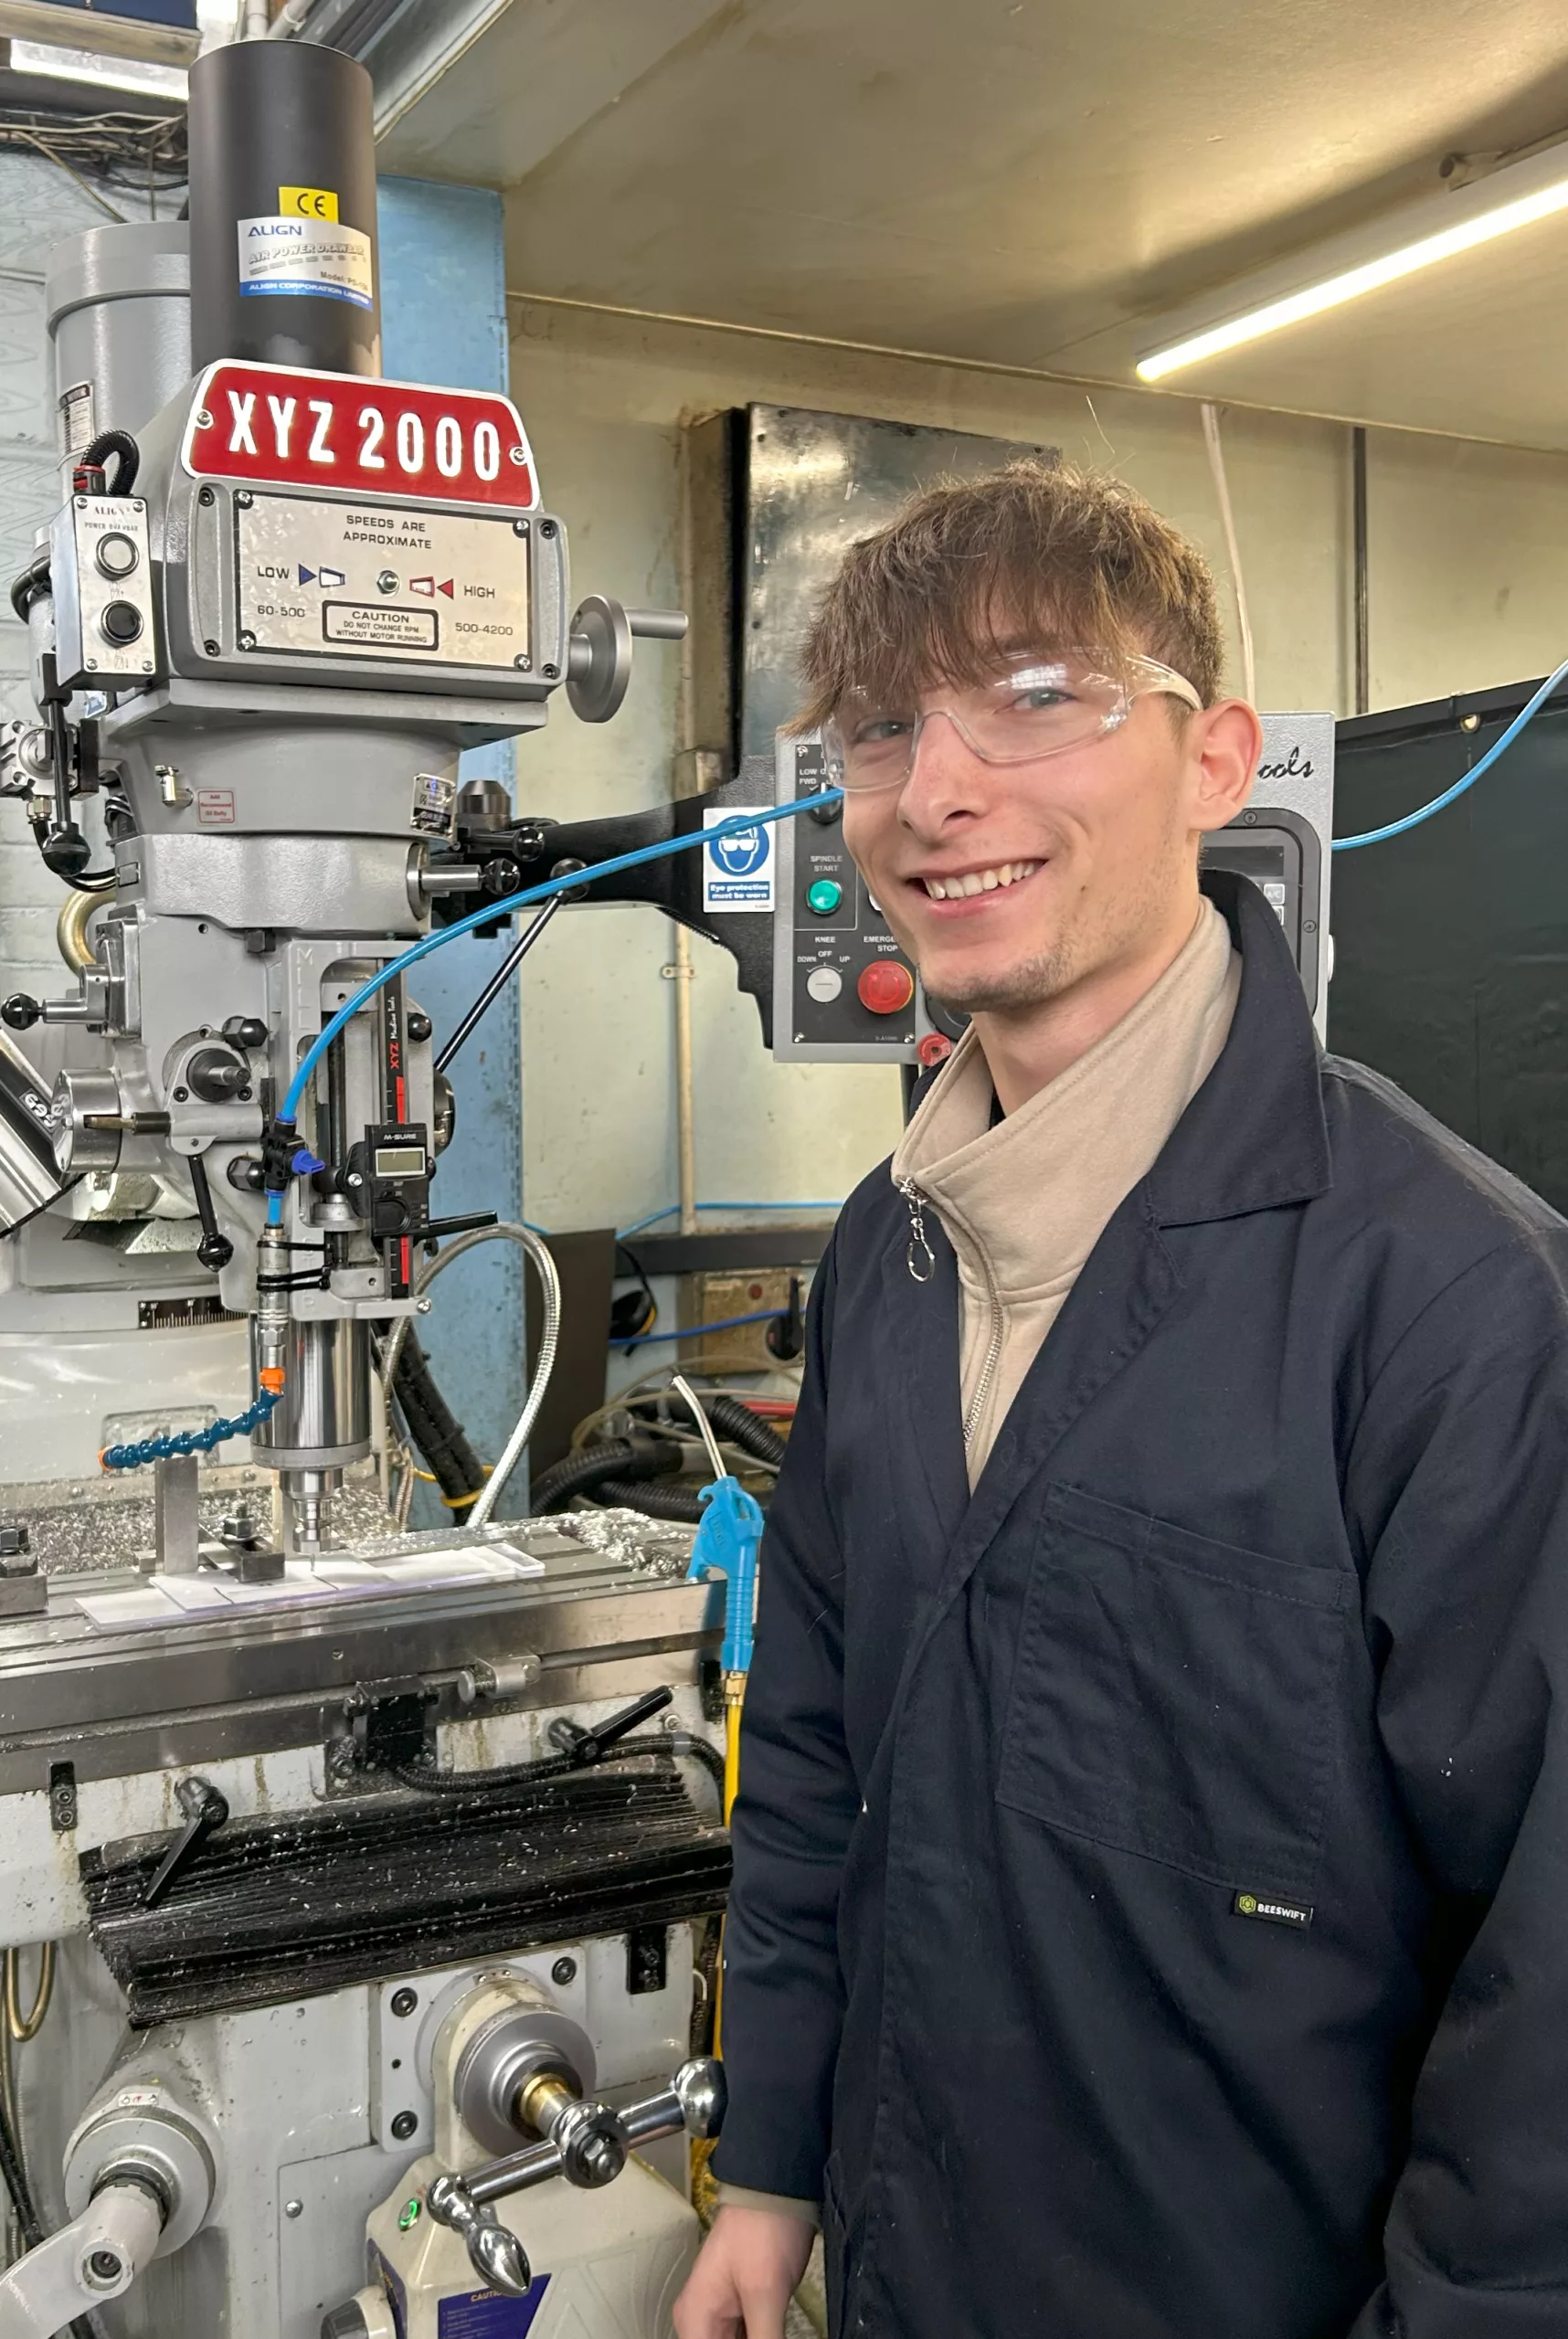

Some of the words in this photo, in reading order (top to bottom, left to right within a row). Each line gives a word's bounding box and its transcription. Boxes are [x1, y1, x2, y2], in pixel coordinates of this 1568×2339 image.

[297, 193, 325, 217] CE
[248, 225, 302, 237] ALIGN
[249, 249, 270, 264] AIR
[272, 243, 315, 258] POWER
[279, 282, 343, 294] CORPORATION
[228, 390, 334, 463] XYZ
[358, 407, 501, 482] 2000
[346, 515, 395, 528] SPEEDS
[401, 521, 426, 532] ARE
[343, 532, 432, 549] APPROXIMATE
[257, 566, 290, 579] LOW
[463, 585, 495, 598] HIGH
[258, 605, 305, 618] 60-500
[352, 611, 409, 623] CAUTION
[373, 624, 402, 632] CHANGE
[455, 622, 514, 636] 500-4200
[335, 629, 366, 638] WITHOUT
[370, 631, 395, 640] MOTOR
[397, 635, 428, 643] RUNNING
[1257, 746, 1314, 779] ools
[710, 884, 726, 893] Eye
[726, 884, 768, 893] protection
[387, 996, 396, 1012] Tools
[389, 1042, 399, 1069] XYZ
[1257, 1903, 1307, 1921] BEESWIFT
[471, 2291, 502, 2302] CAUTI
